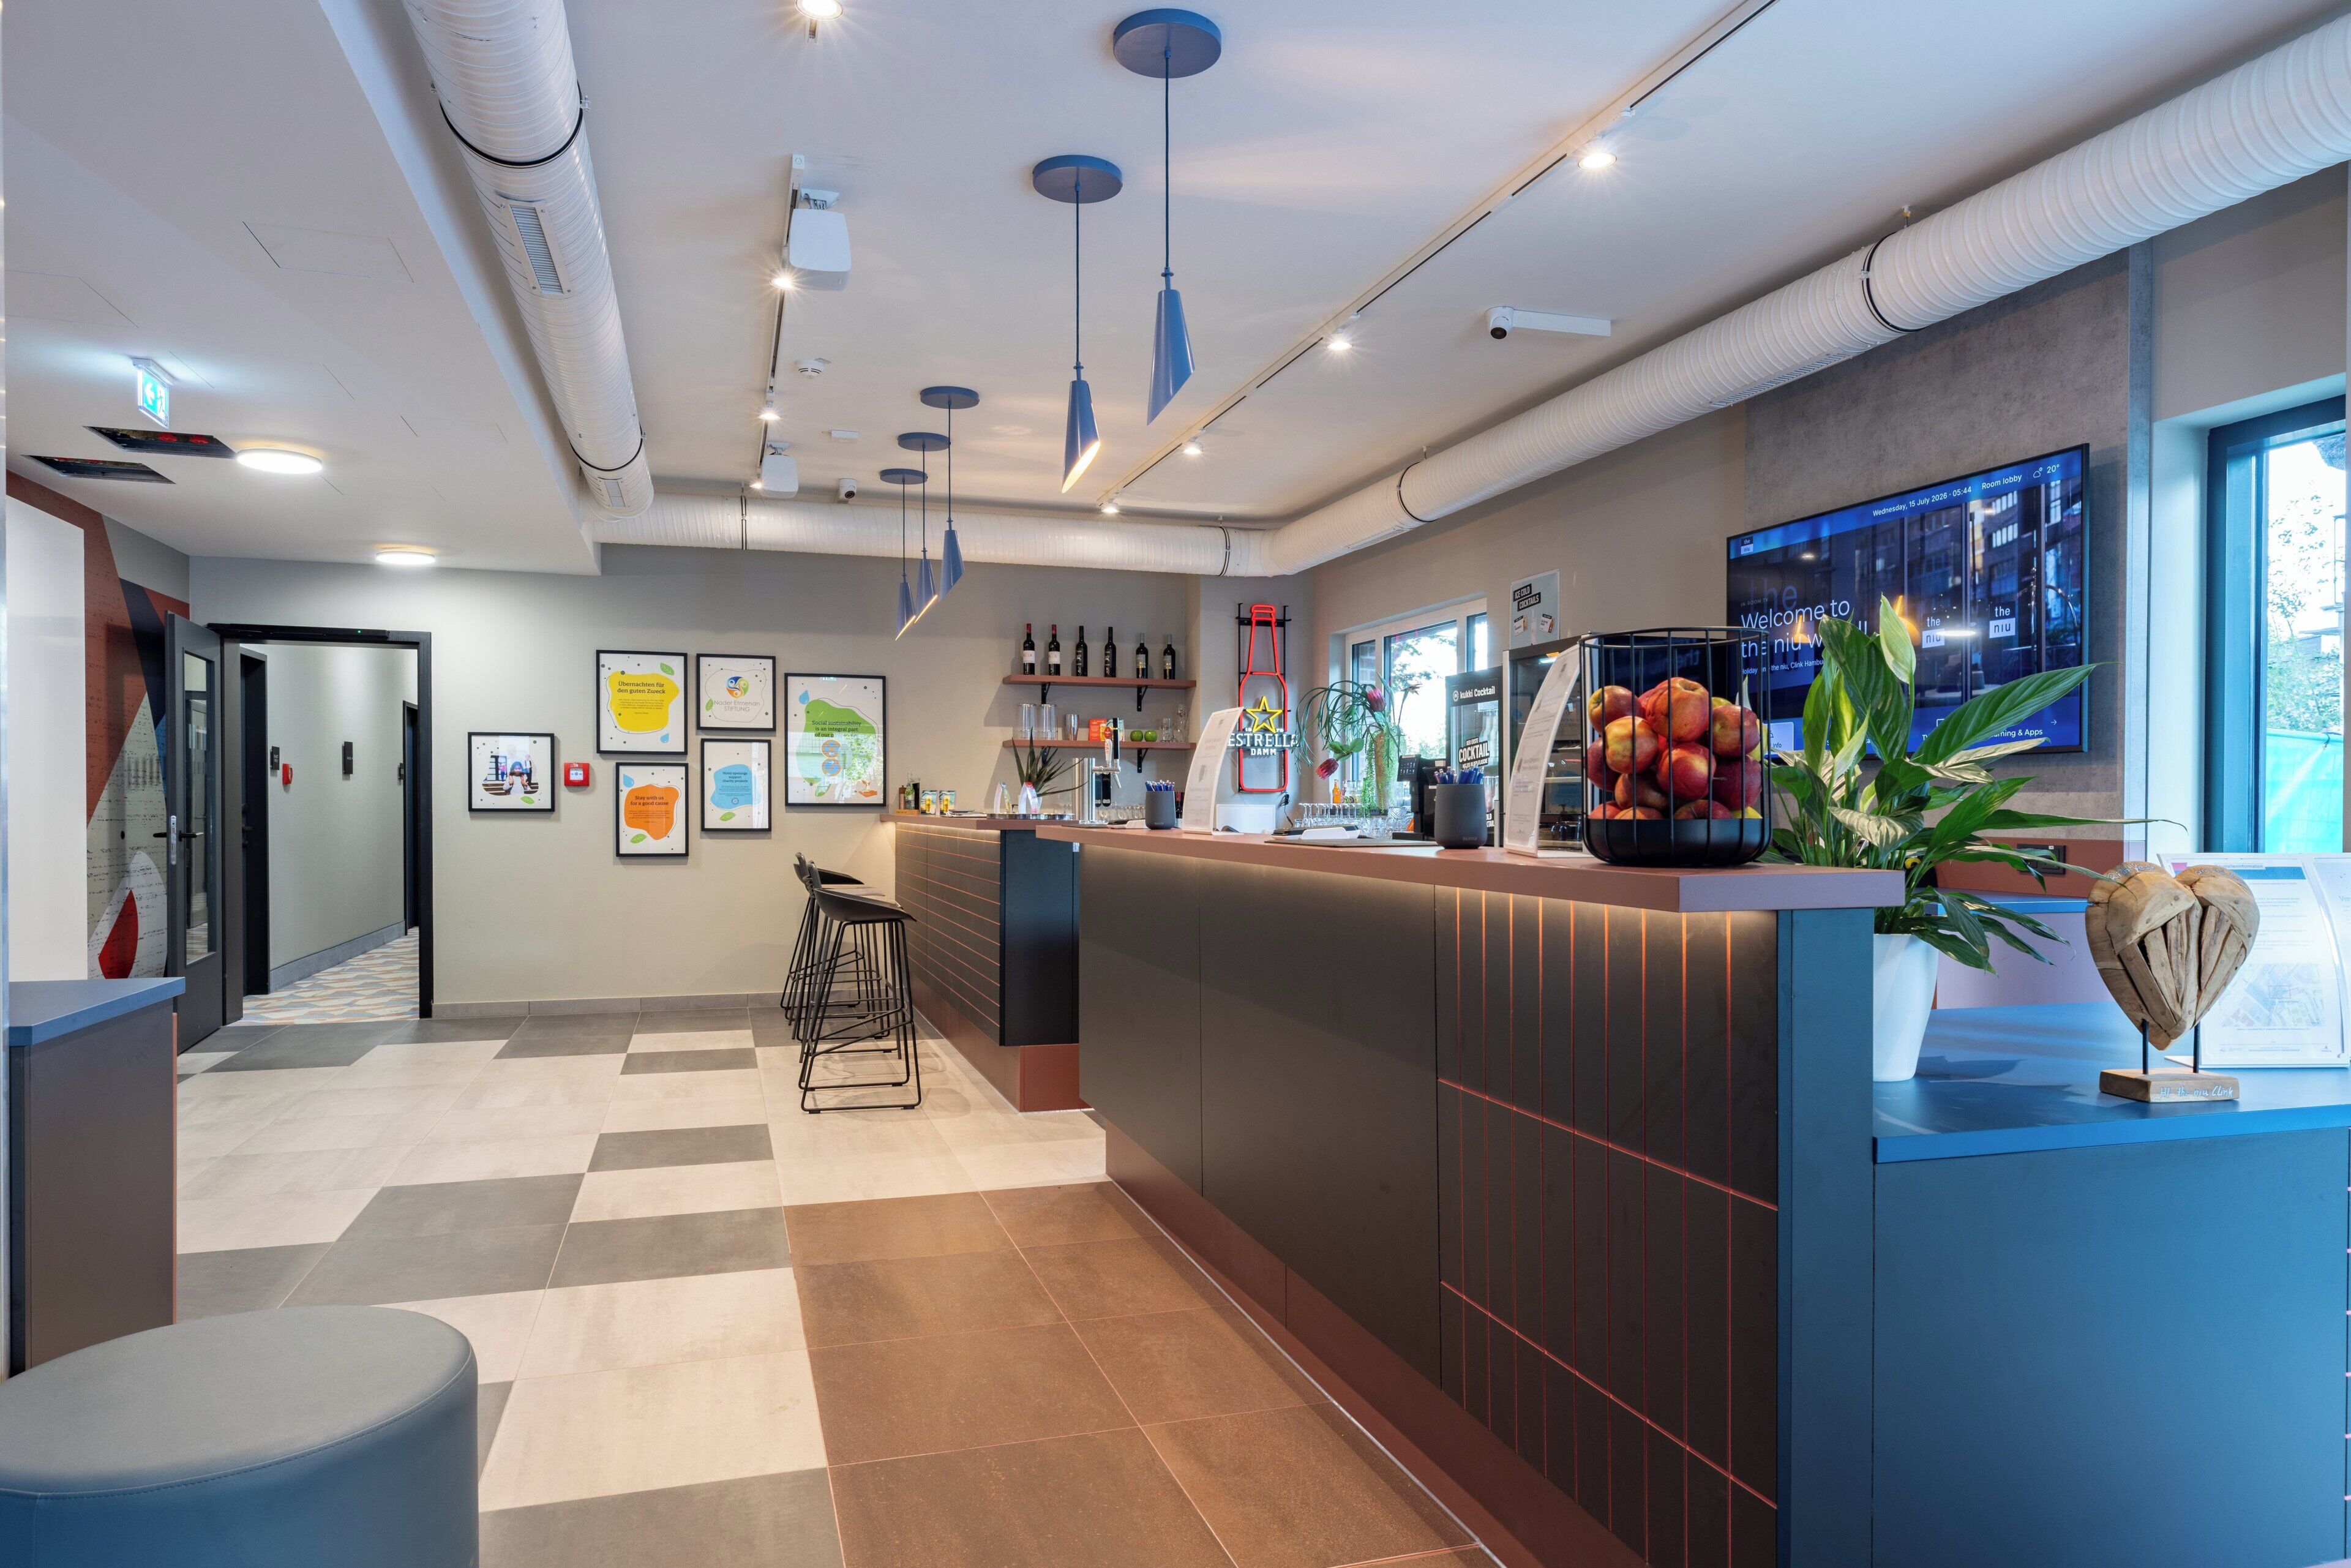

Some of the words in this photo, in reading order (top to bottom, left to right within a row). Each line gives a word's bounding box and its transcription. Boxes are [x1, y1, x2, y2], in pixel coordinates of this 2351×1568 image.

[2047, 464, 2060, 474] 20°
[1982, 479, 2001, 490] Room
[2003, 474, 2022, 486] lobby
[1872, 503, 1908, 517] Wednesday,
[1917, 496, 1930, 506] July
[1931, 492, 1948, 502] 2026
[1952, 486, 1971, 497] 05:44
[1521, 586, 1530, 597] COLD
[1519, 595, 1539, 609] COCKTAILS
[1741, 605, 1824, 629] Welcome
[1830, 599, 1850, 618] to
[1995, 606, 2011, 618] the
[1927, 616, 1941, 628] the
[1994, 623, 2011, 633] niu
[1774, 632, 1801, 653] niu
[1926, 633, 1941, 643] niu
[1460, 689, 1473, 699] kukki
[1474, 686, 1495, 697] Cocktail
[1227, 733, 1299, 747] ESTRELLA
[1458, 742, 1490, 763] COCKTAIL
